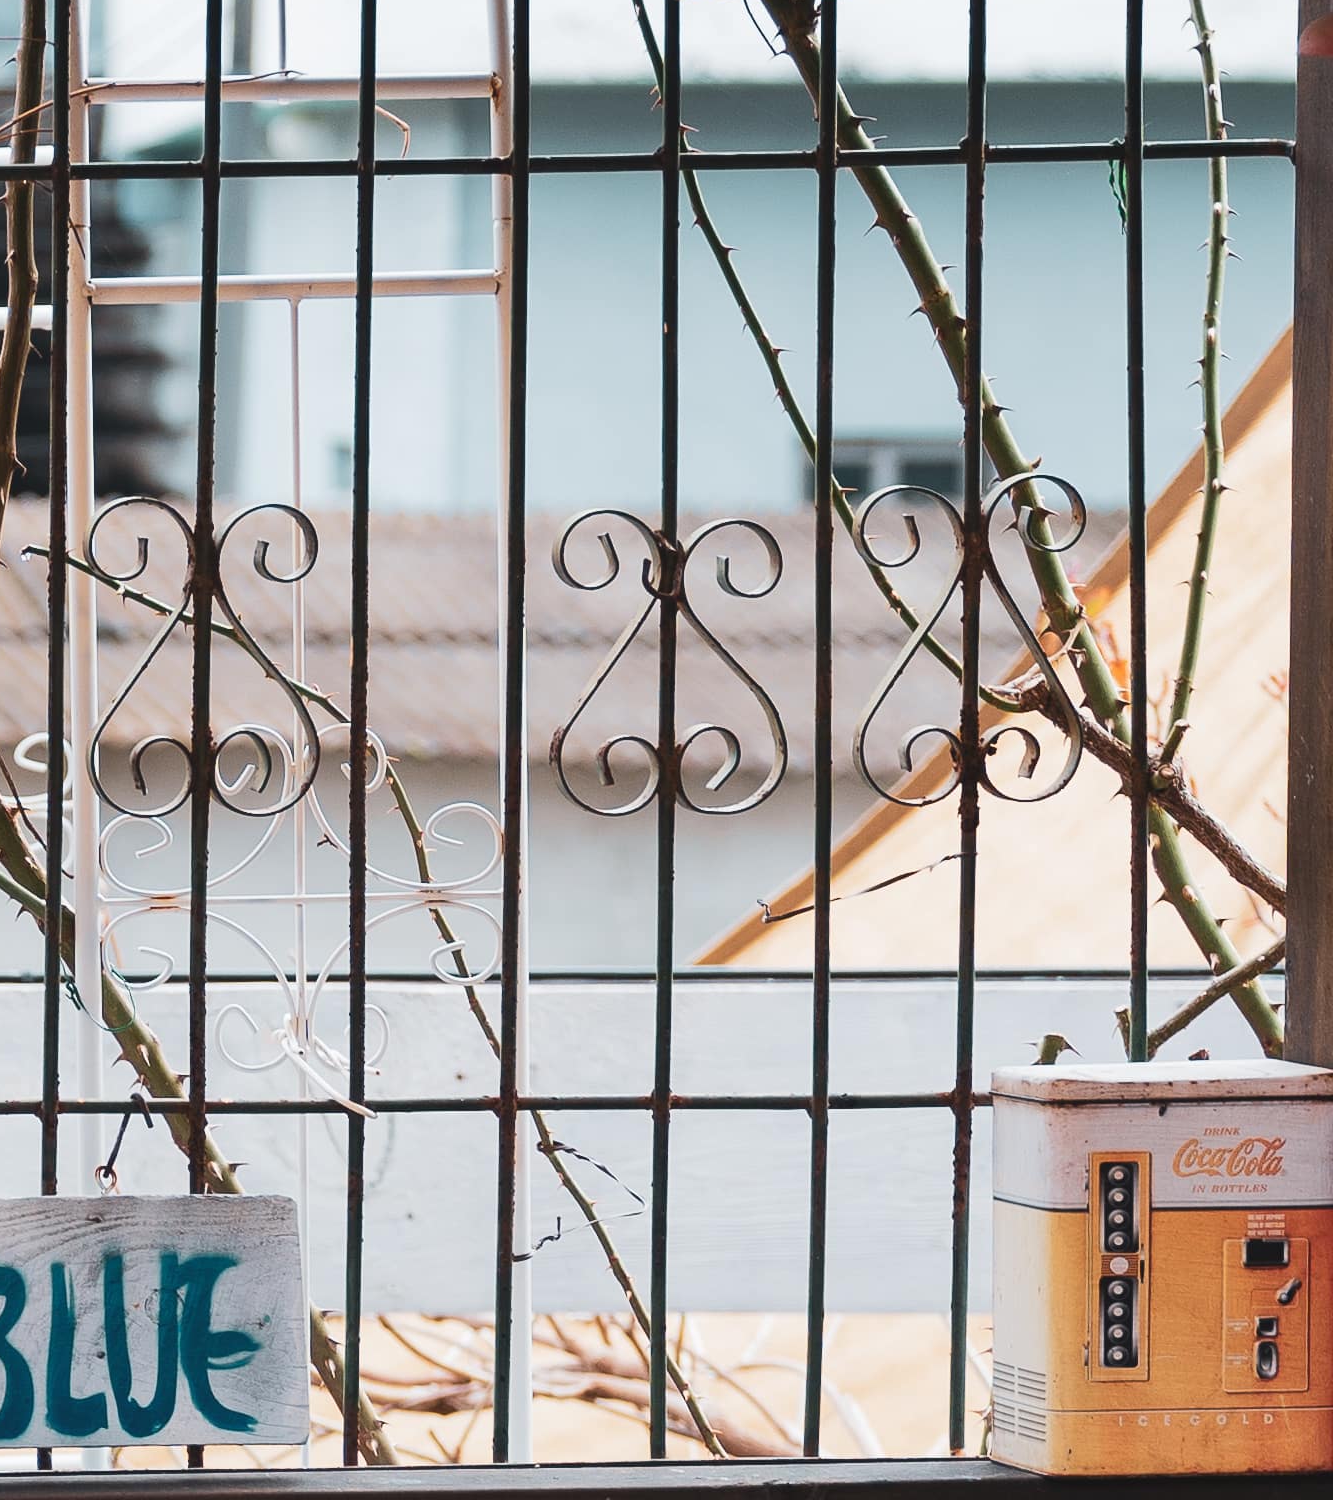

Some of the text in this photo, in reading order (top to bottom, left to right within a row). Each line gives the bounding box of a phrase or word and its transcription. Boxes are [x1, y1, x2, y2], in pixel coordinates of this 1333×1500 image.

[1203, 1127, 1241, 1137] DRINK
[1172, 1136, 1287, 1178] Coca-Cola
[1191, 1183, 1269, 1194] IN BOTTLES
[1118, 1412, 1274, 1427] ICE COLD
